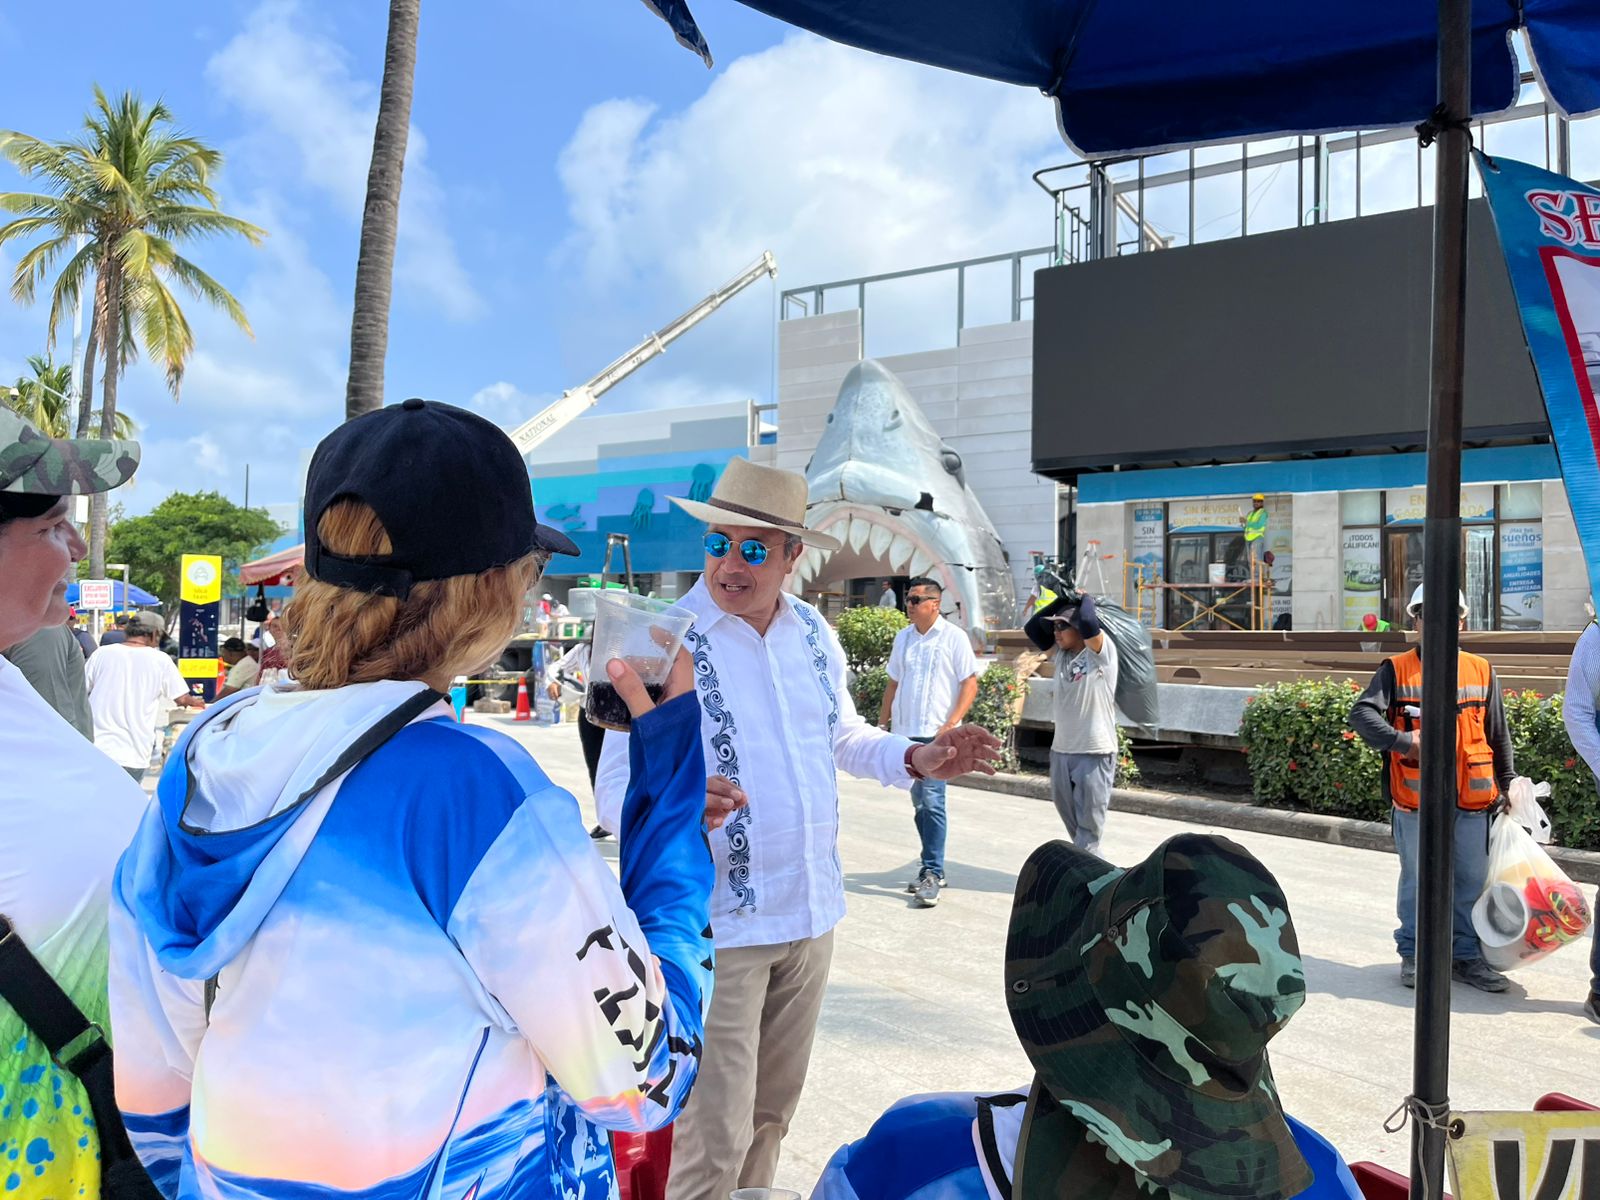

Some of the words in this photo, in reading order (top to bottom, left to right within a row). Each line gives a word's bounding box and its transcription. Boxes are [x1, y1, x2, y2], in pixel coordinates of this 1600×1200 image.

[518, 413, 556, 442] NATIONAL
[1184, 505, 1200, 515] SIN
[1201, 503, 1240, 514] REVISAR
[1142, 526, 1156, 536] SIN
[1502, 532, 1543, 542] sueños
[1509, 579, 1535, 587] ENTREGA
[1502, 584, 1542, 593] GARANTIZADA
